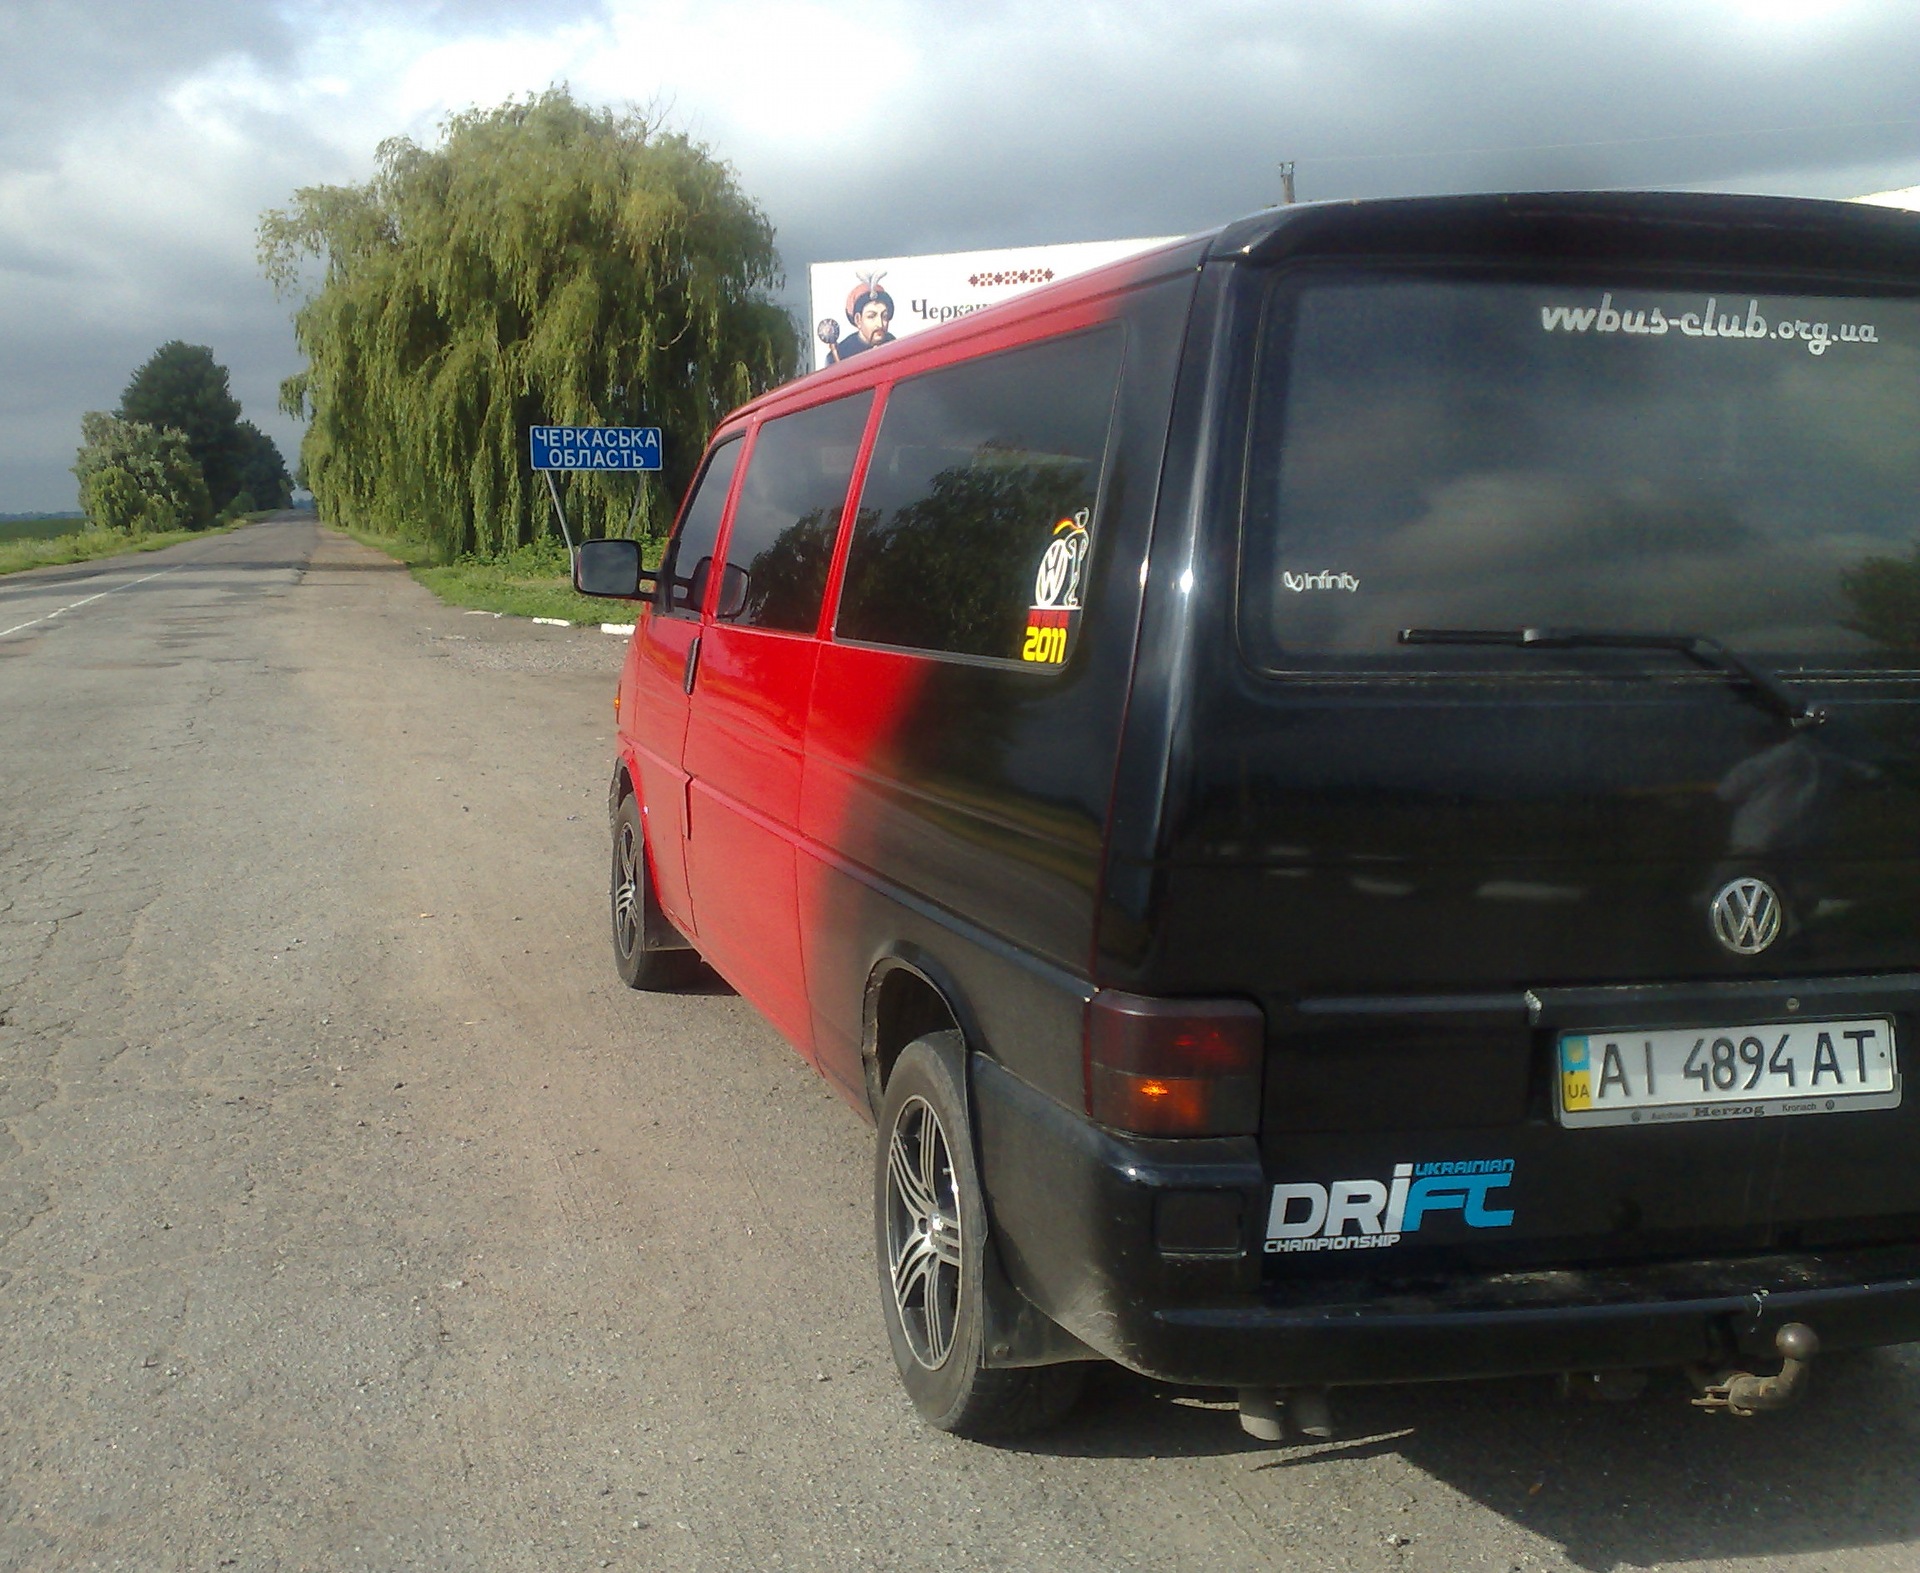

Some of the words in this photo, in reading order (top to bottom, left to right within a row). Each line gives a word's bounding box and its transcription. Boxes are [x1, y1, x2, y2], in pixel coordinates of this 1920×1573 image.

[1542, 292, 1879, 356] vwbus-club.org.ua
[535, 429, 658, 448] ЧЕРКАСЬКА
[548, 448, 645, 467] ОБЛАСТЬ
[1023, 626, 1067, 664] 2011
[1683, 1033, 1796, 1092] 4894
[1809, 1029, 1877, 1087] AT
[1567, 1084, 1590, 1099] UA
[1693, 1104, 1765, 1117] Herzog
[1415, 1158, 1515, 1176] UKRAINIAN
[1264, 1234, 1401, 1253] CHAMPIONSHIP
